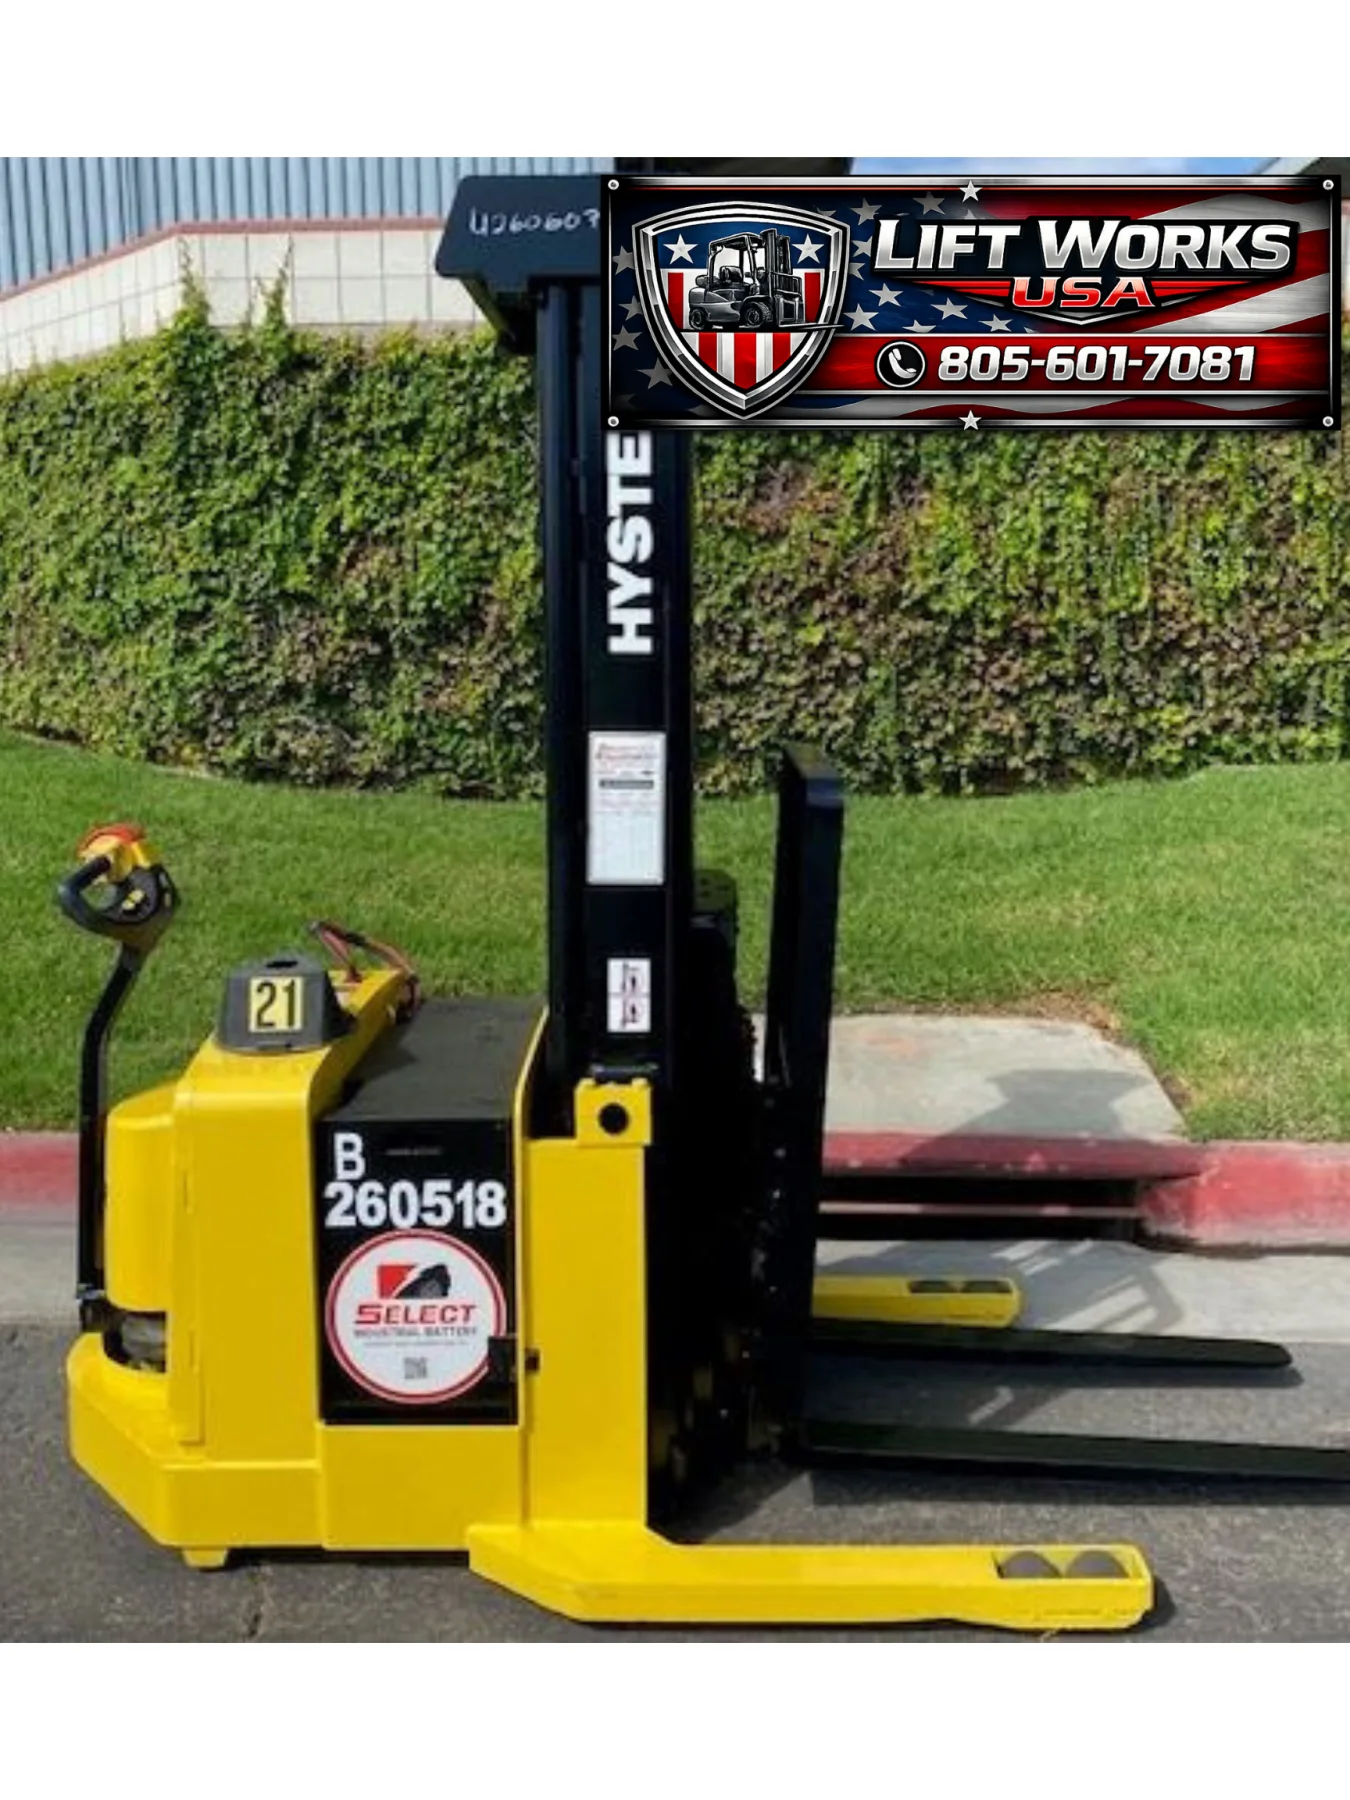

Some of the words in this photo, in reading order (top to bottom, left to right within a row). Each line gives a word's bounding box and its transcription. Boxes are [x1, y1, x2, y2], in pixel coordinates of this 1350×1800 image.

[255, 981, 298, 1028] 21
[333, 1132, 365, 1180] B
[324, 1180, 507, 1229] 260518
[354, 1304, 477, 1325] SELECT
